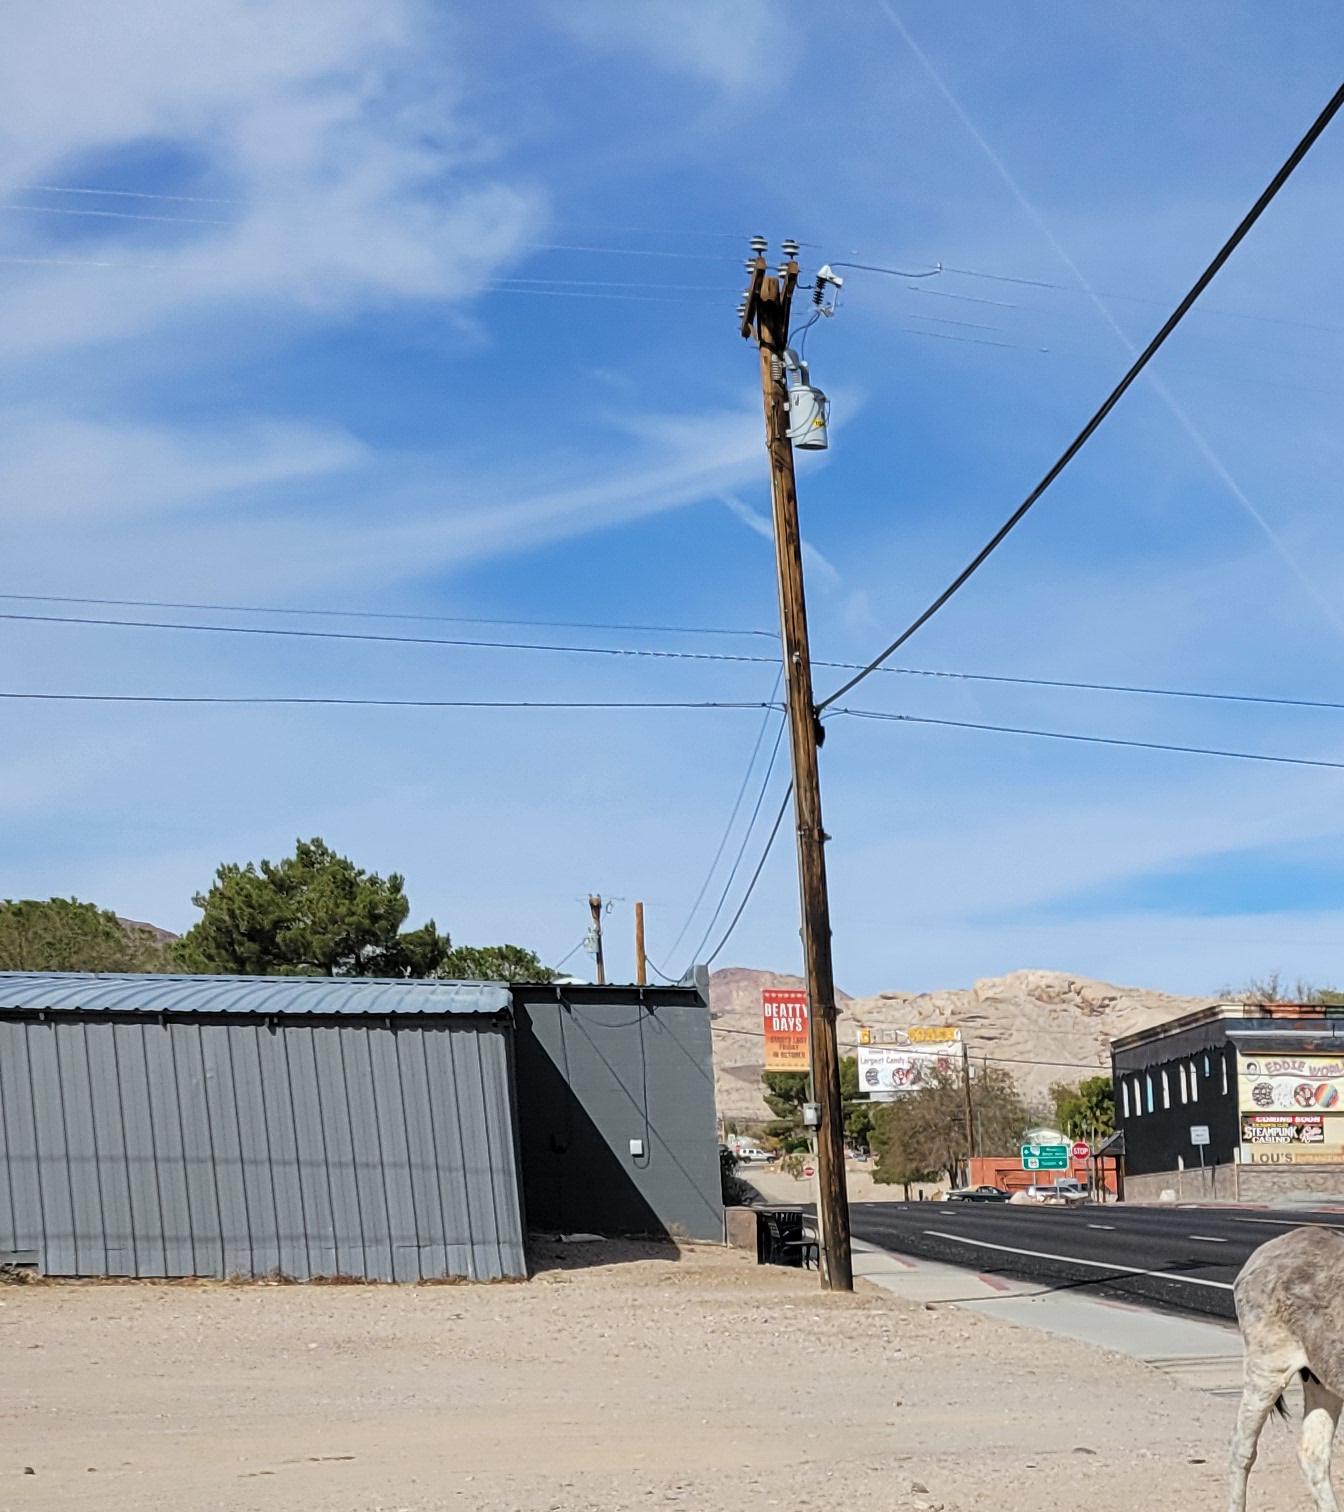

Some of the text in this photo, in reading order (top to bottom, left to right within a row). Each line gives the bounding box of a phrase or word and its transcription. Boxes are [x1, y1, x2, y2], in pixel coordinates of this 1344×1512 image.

[764, 1003, 808, 1018] BEATTY
[772, 1017, 803, 1032] DAYS
[1264, 1061, 1306, 1074] EDDIE
[1243, 1125, 1298, 1140] STEAMPUNK
[1252, 1136, 1291, 1144] CASINO
[1251, 1152, 1293, 1163] LOU'S
